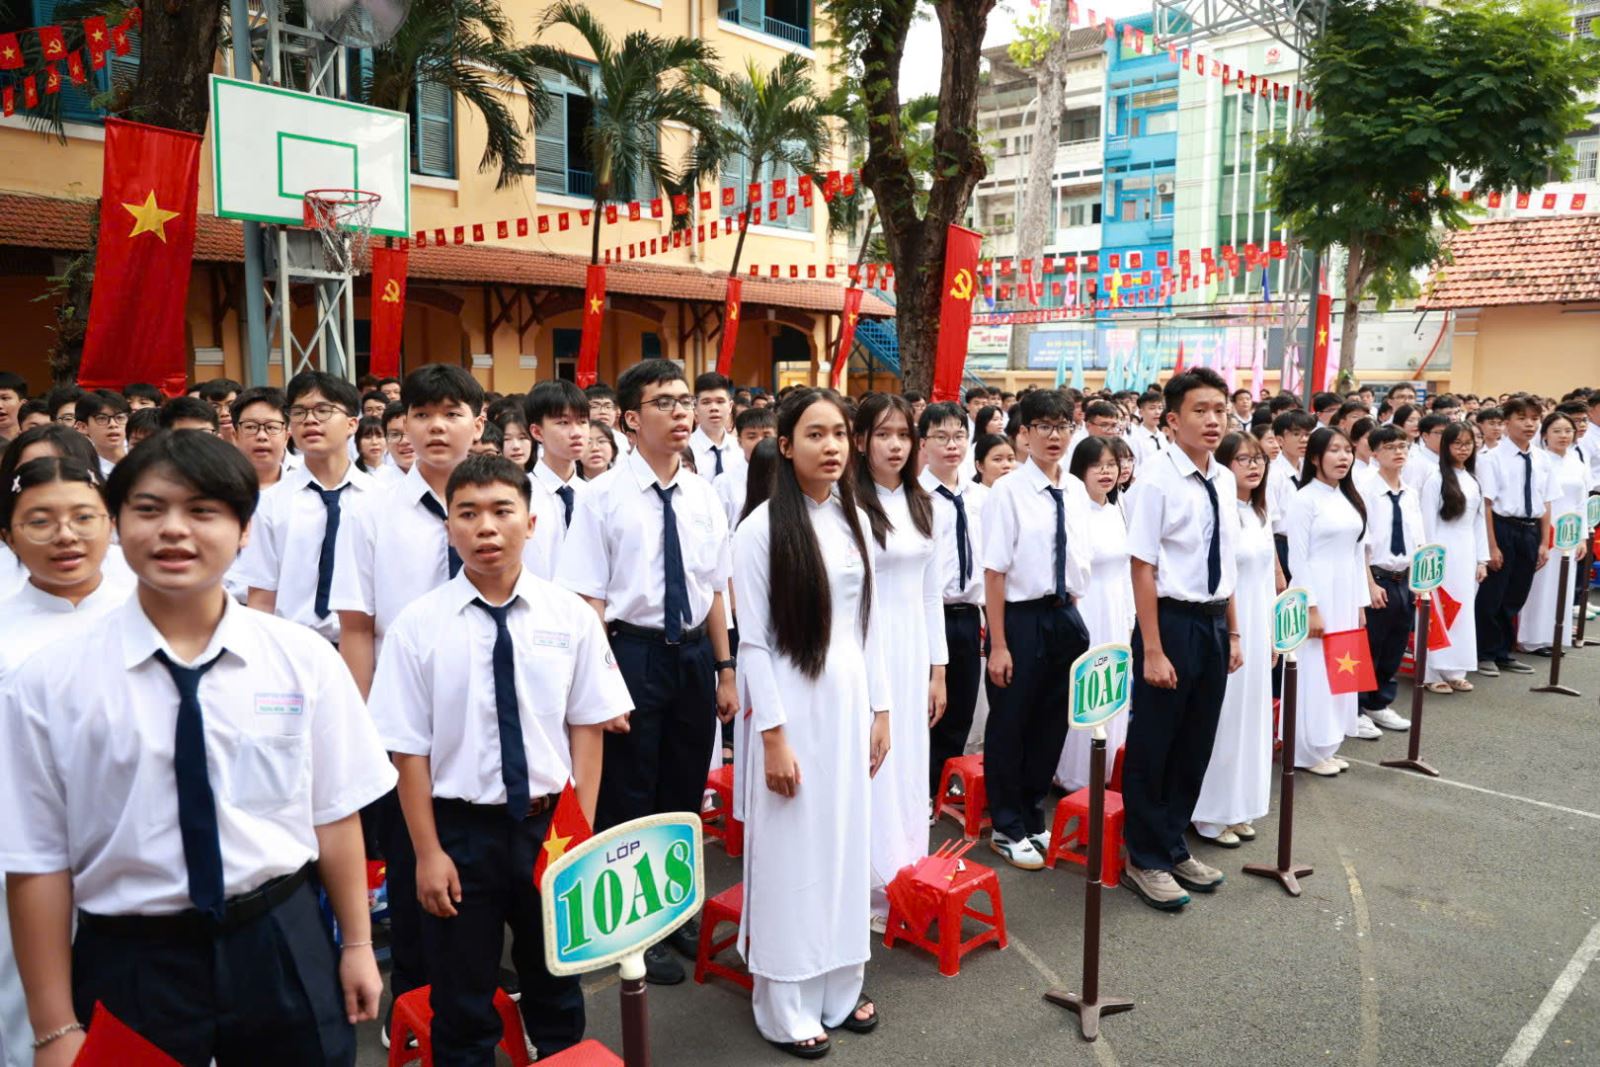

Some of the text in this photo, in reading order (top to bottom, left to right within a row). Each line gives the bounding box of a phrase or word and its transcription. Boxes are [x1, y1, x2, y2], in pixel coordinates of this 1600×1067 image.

[1413, 556, 1443, 583] 10A5
[1275, 604, 1306, 641] 10A6
[1075, 662, 1127, 715] 10A7
[606, 840, 641, 864] LỚP
[560, 841, 693, 953] 10A8
